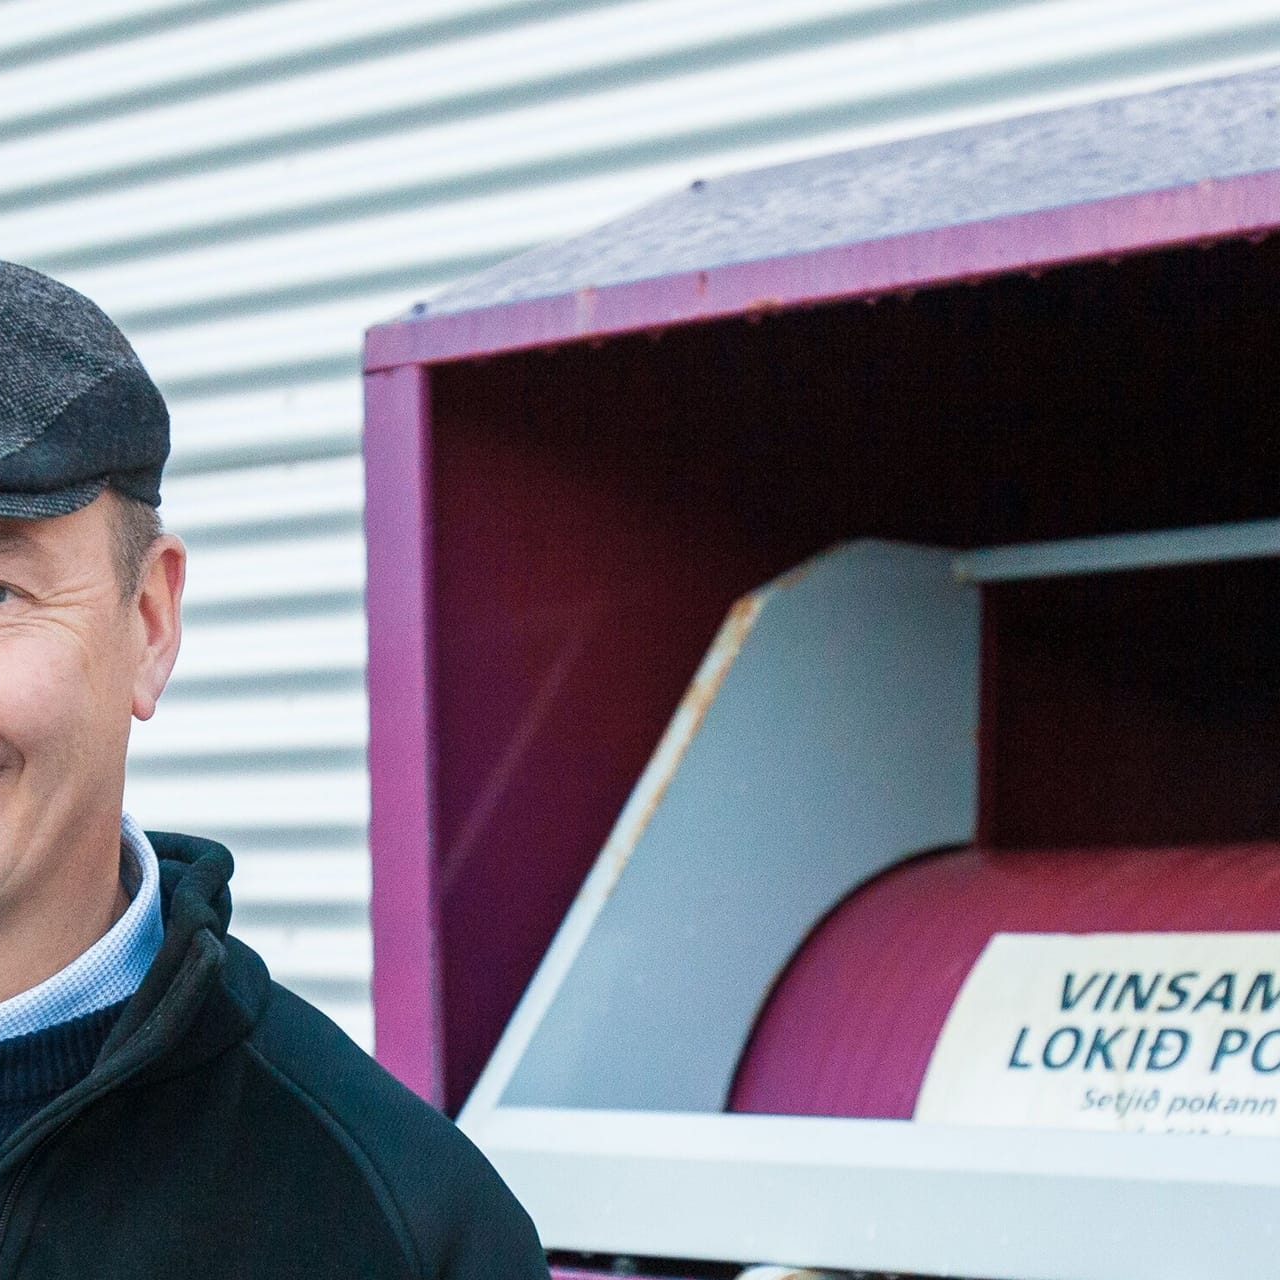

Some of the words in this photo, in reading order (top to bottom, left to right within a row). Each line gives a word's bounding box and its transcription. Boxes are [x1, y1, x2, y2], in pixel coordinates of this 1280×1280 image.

[1007, 1026, 1194, 1073] LOKIÐ
[1080, 1086, 1162, 1119] Setjið
[1165, 1090, 1278, 1120] pokann
